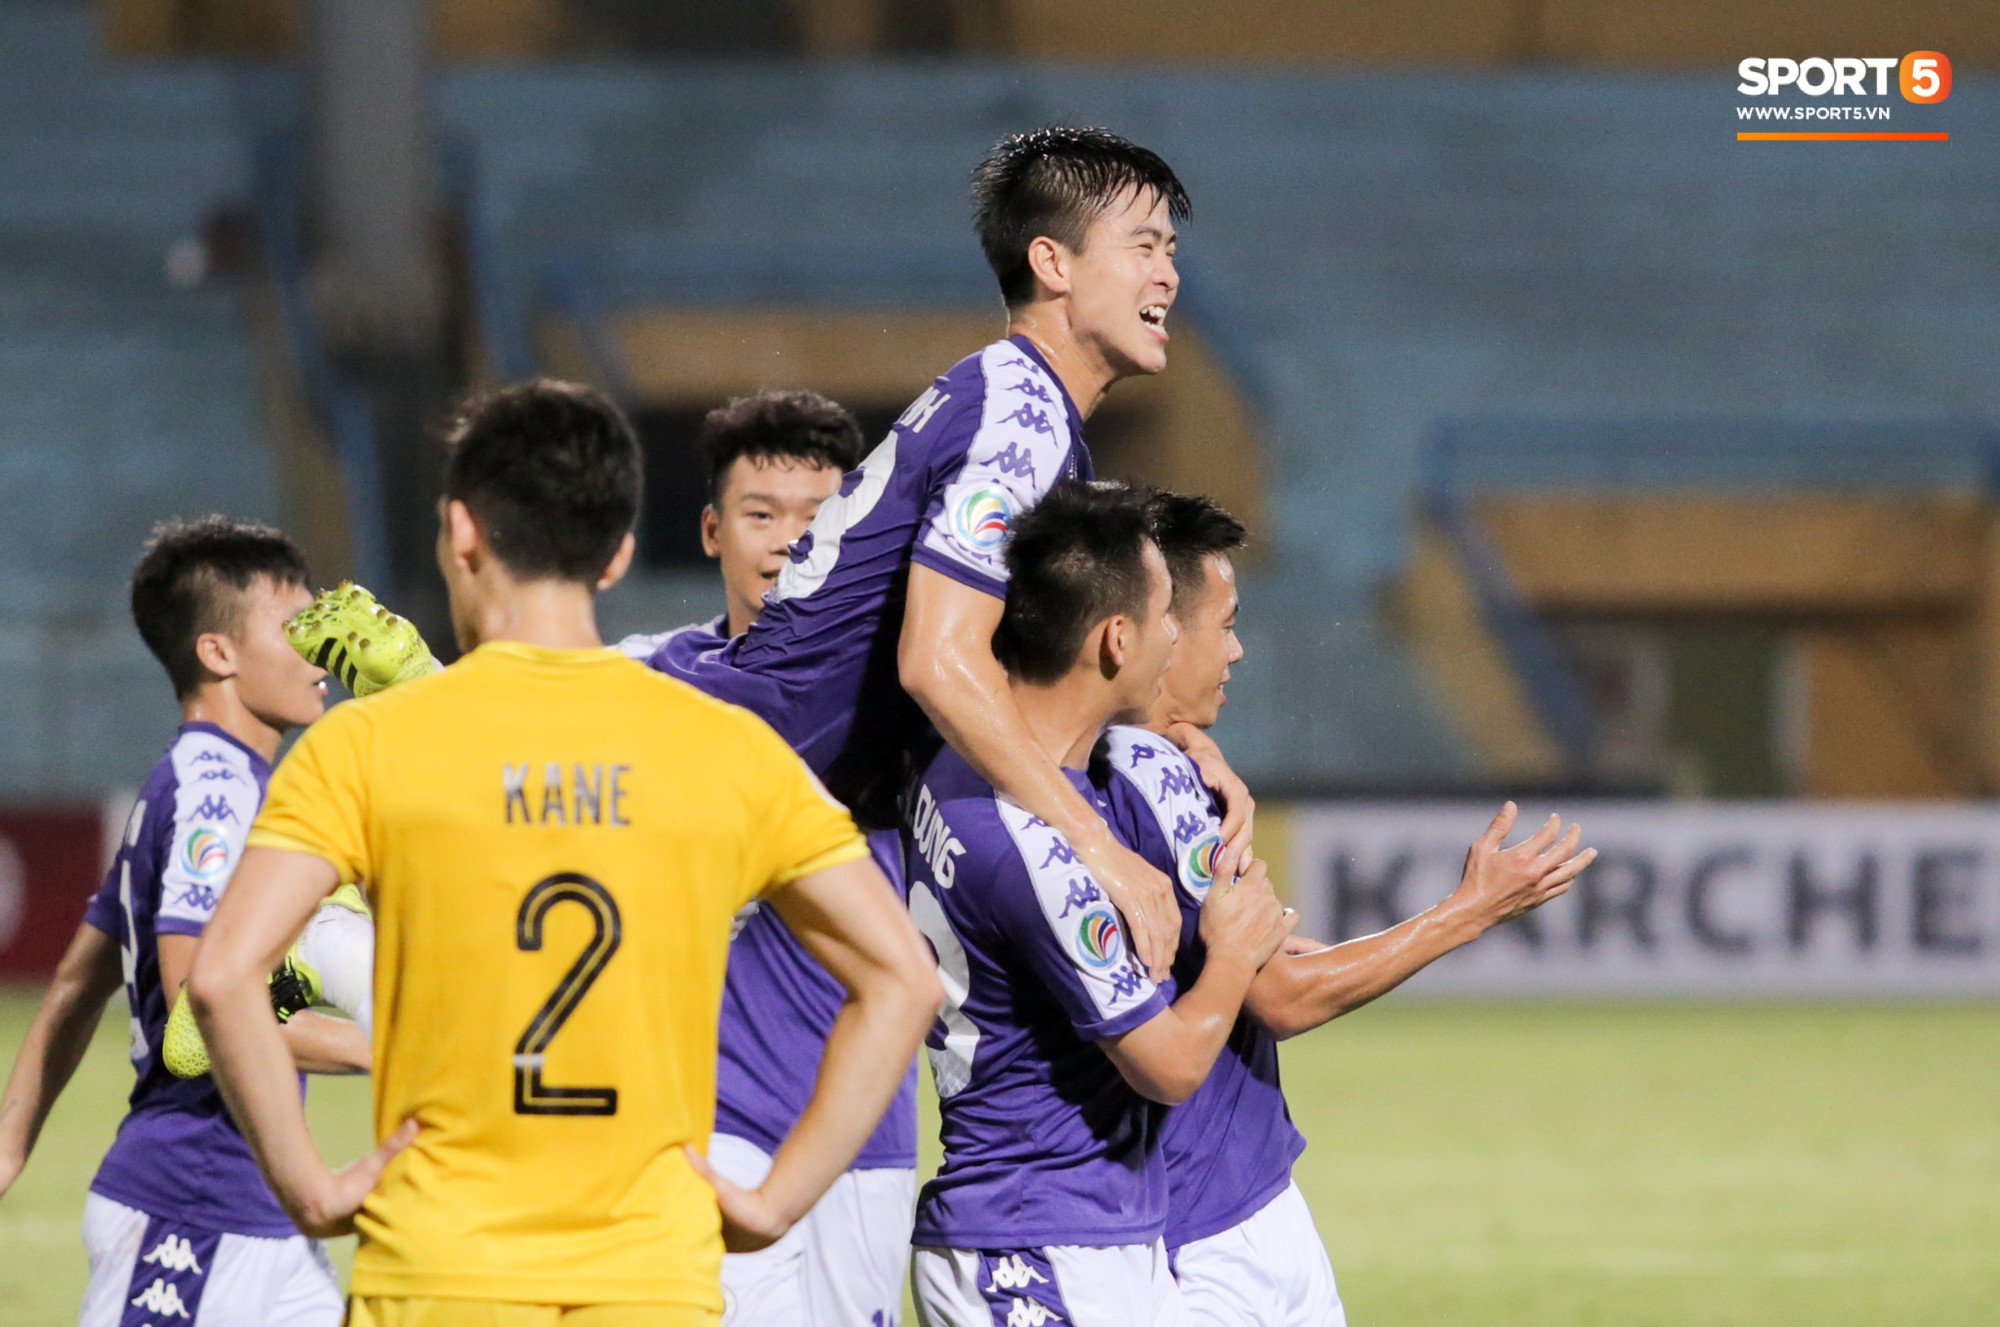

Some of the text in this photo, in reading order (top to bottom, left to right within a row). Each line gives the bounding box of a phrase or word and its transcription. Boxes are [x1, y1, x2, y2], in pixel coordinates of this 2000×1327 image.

[503, 763, 632, 825] KANE
[1328, 842, 1986, 956] KRCHE
[513, 871, 622, 1115] 2
